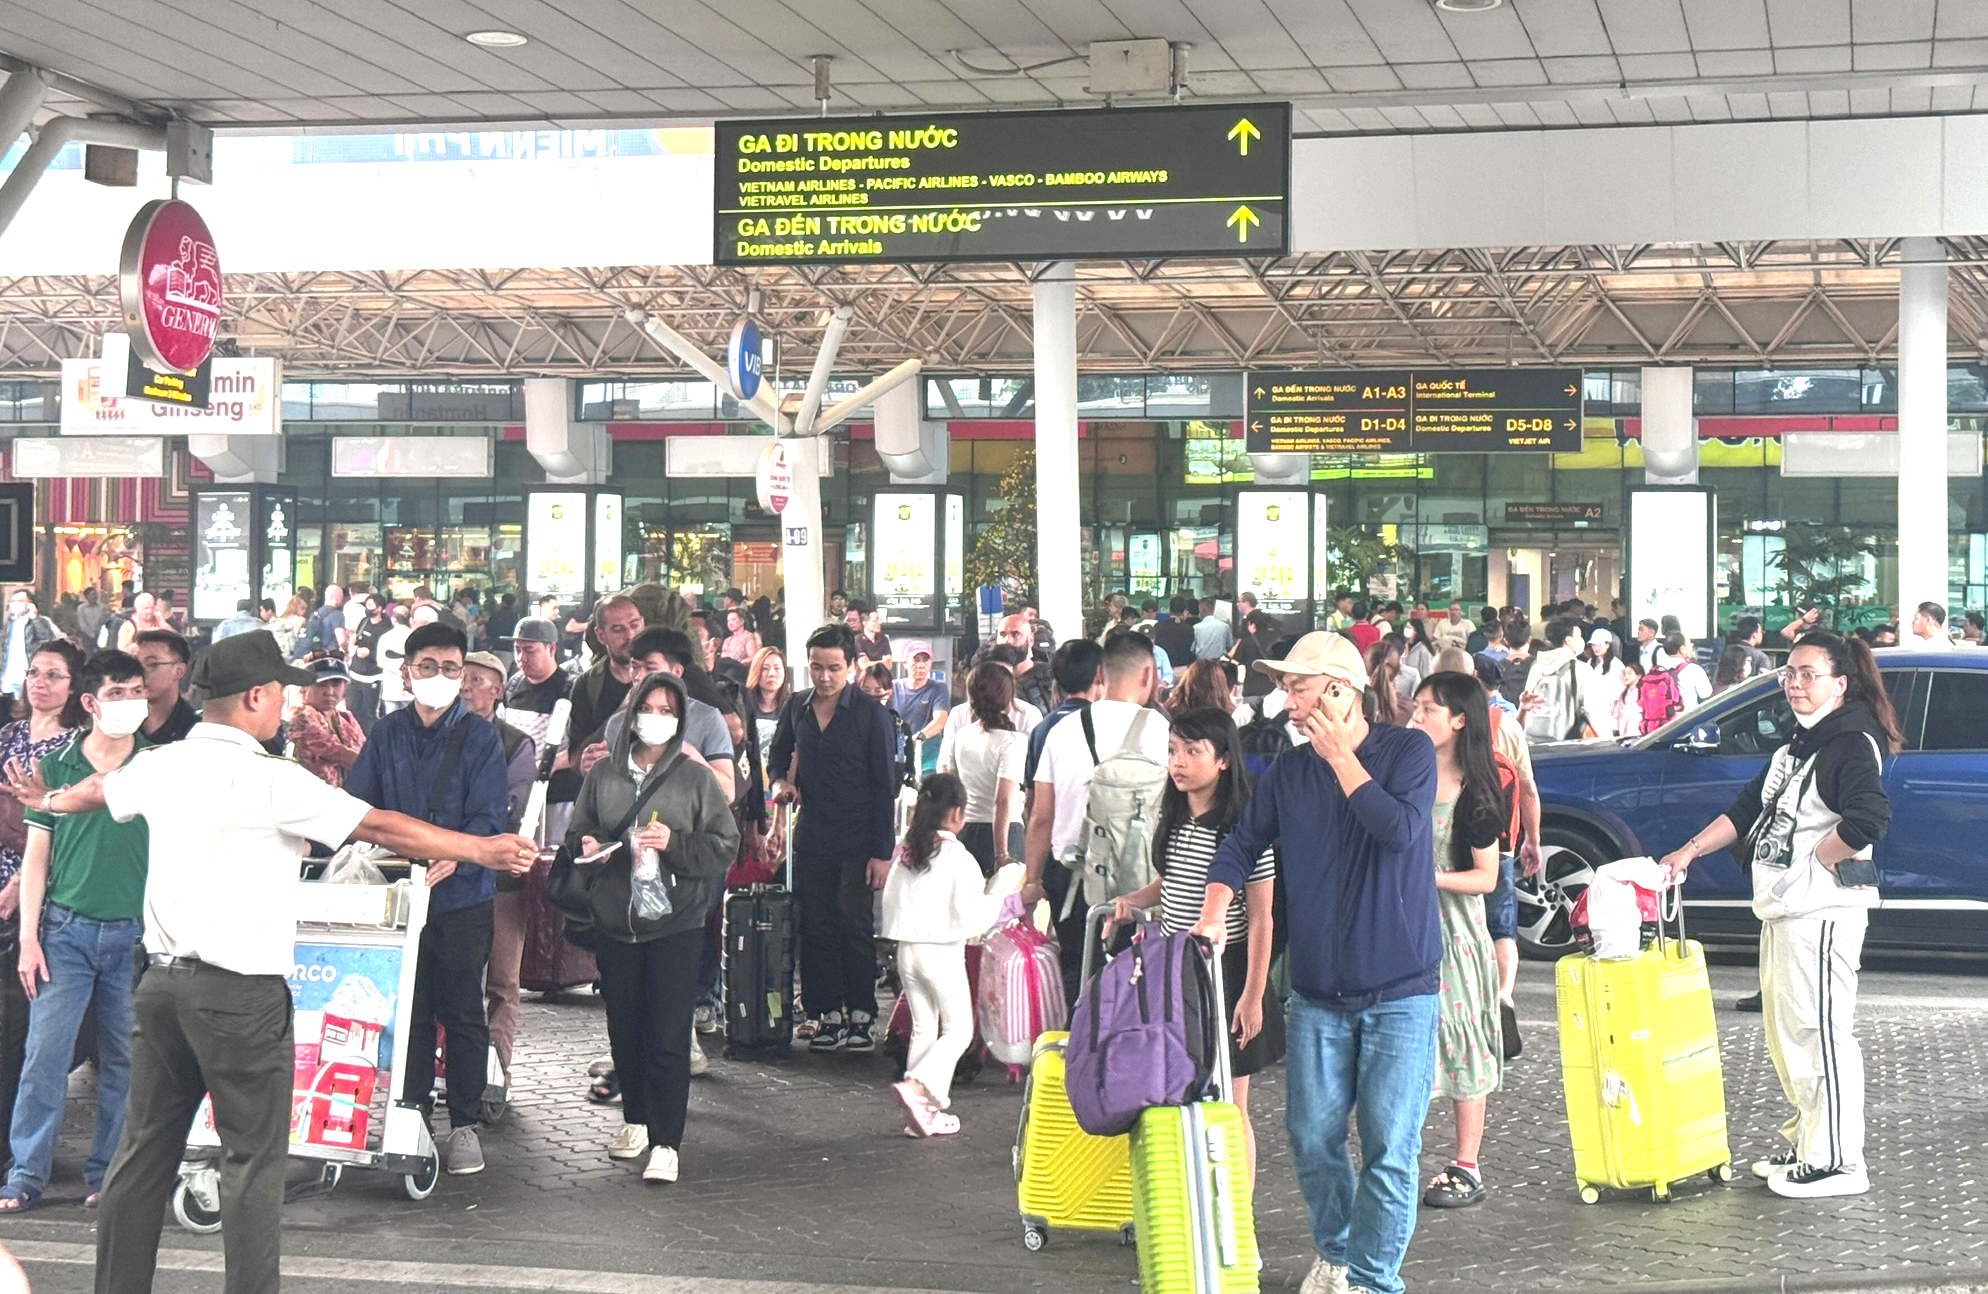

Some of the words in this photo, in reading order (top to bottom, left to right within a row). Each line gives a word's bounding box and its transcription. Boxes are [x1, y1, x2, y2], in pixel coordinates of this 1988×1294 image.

[738, 134, 771, 154] GA
[776, 134, 798, 152] ĐI
[804, 131, 883, 152] TRONG
[889, 125, 958, 149] NƯỚC
[738, 157, 815, 173] Domestic
[819, 155, 910, 173] Departures
[739, 180, 795, 193] VIETNAM
[797, 179, 856, 192] AIRLINES
[866, 176, 916, 190] PACIFIC
[918, 175, 979, 189] AIRLINES
[988, 174, 1035, 187] VASCO
[1045, 172, 1105, 186] BAMBOO
[1107, 170, 1168, 185] AIRWAYS
[738, 195, 807, 207] VIETRAVEL
[809, 193, 869, 205] AIRLINES
[737, 218, 771, 237] GA
[826, 215, 906, 234] TRONG
[911, 209, 981, 233] NƯỚC
[737, 241, 814, 257] Domestic
[817, 239, 883, 255] Arrivals
[744, 350, 762, 376] VIB
[1304, 385, 1332, 393] TRONG
[1415, 382, 1428, 390] GA
[1429, 379, 1453, 390] QUỐC
[1362, 386, 1406, 399] A1-A3
[1270, 416, 1283, 424] GA
[1294, 416, 1322, 424] TRONG
[1361, 418, 1406, 431] D1-D4
[1415, 415, 1428, 423] GA
[1440, 415, 1468, 423] TRONG
[1506, 419, 1553, 431] D5-D8
[1304, 425, 1344, 434] Departures
[1450, 425, 1491, 433] Departures
[1584, 507, 1601, 518] A2
[284, 964, 337, 982] RCO
